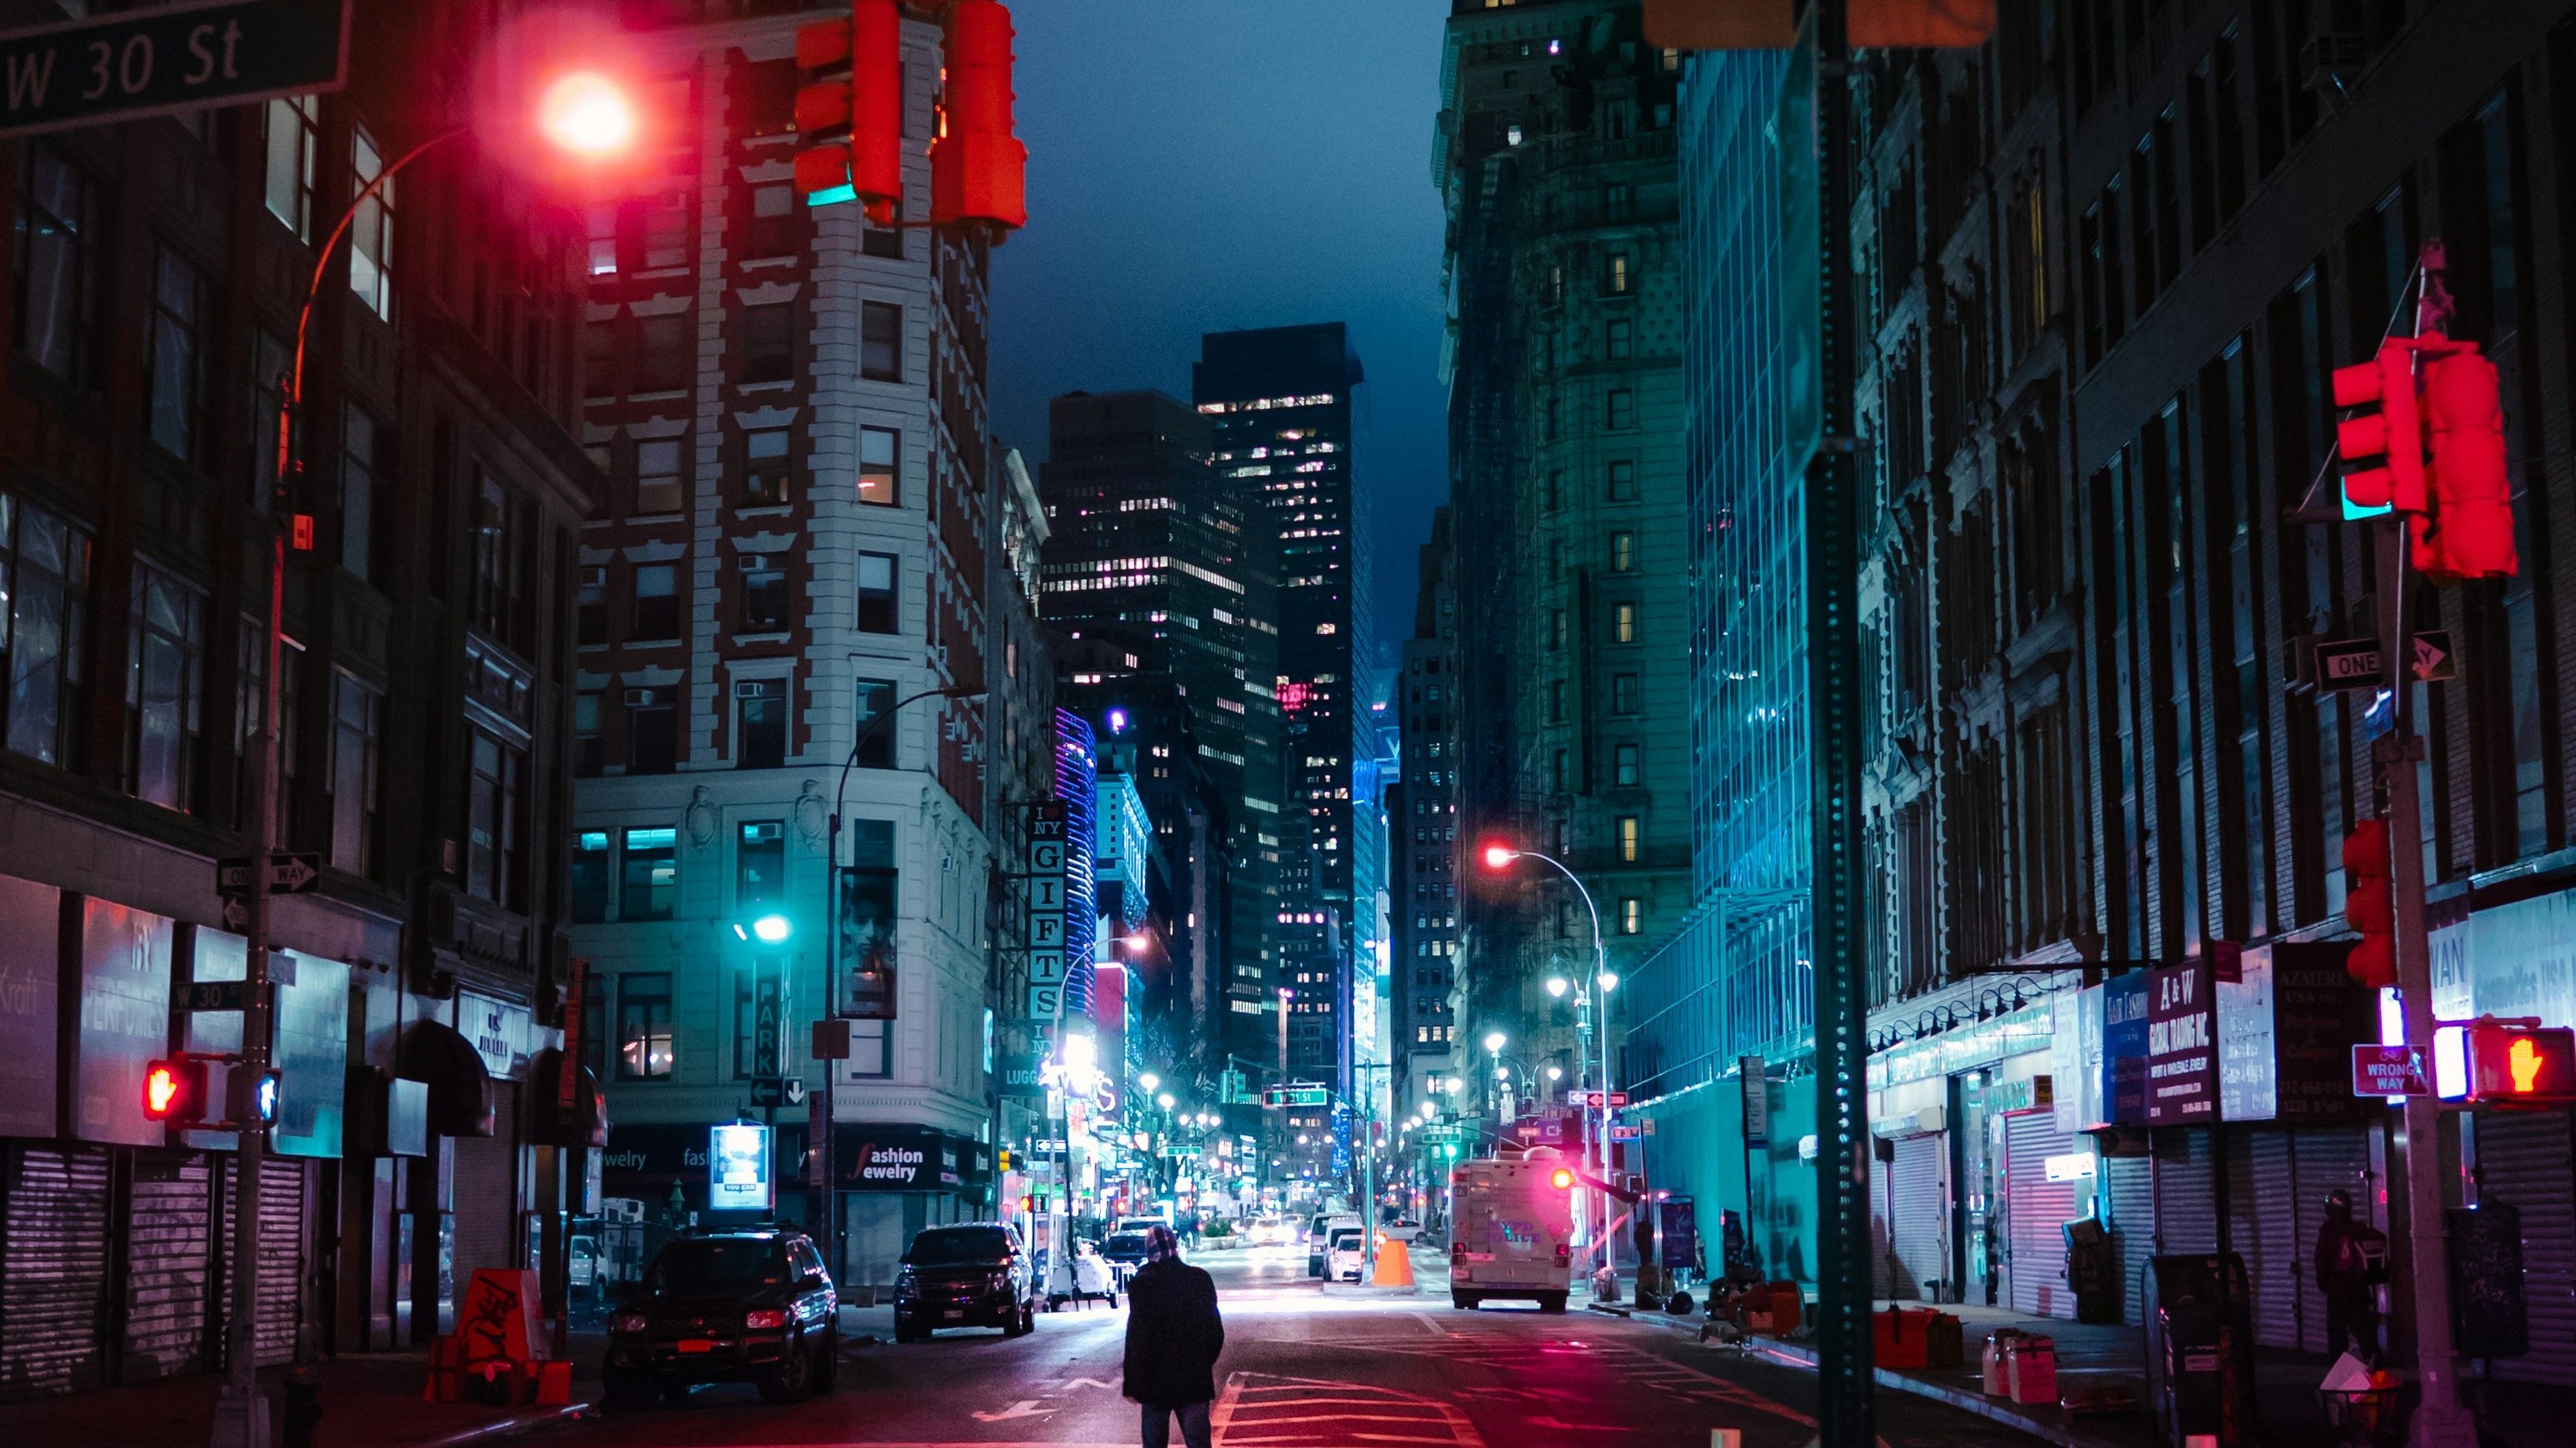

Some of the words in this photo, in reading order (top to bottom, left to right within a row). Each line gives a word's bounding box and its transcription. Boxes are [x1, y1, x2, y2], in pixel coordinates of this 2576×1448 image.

[7, 47, 57, 112] W
[82, 33, 156, 101] 30
[182, 17, 243, 86] St
[2338, 654, 2378, 675] ONE
[1036, 806, 1043, 820] I
[1033, 821, 1062, 835] NY
[231, 869, 250, 884] ON
[278, 867, 308, 881] WAY
[1033, 845, 1061, 1015] GIFTS
[175, 987, 192, 1006] W
[198, 986, 222, 1006] 30
[2160, 976, 2171, 1011] A
[2181, 969, 2195, 1005] W
[2367, 1063, 2415, 1076] WRONG
[2377, 1077, 2405, 1090] WAY
[1278, 1093, 1288, 1103] W
[1290, 1093, 1299, 1103] 31
